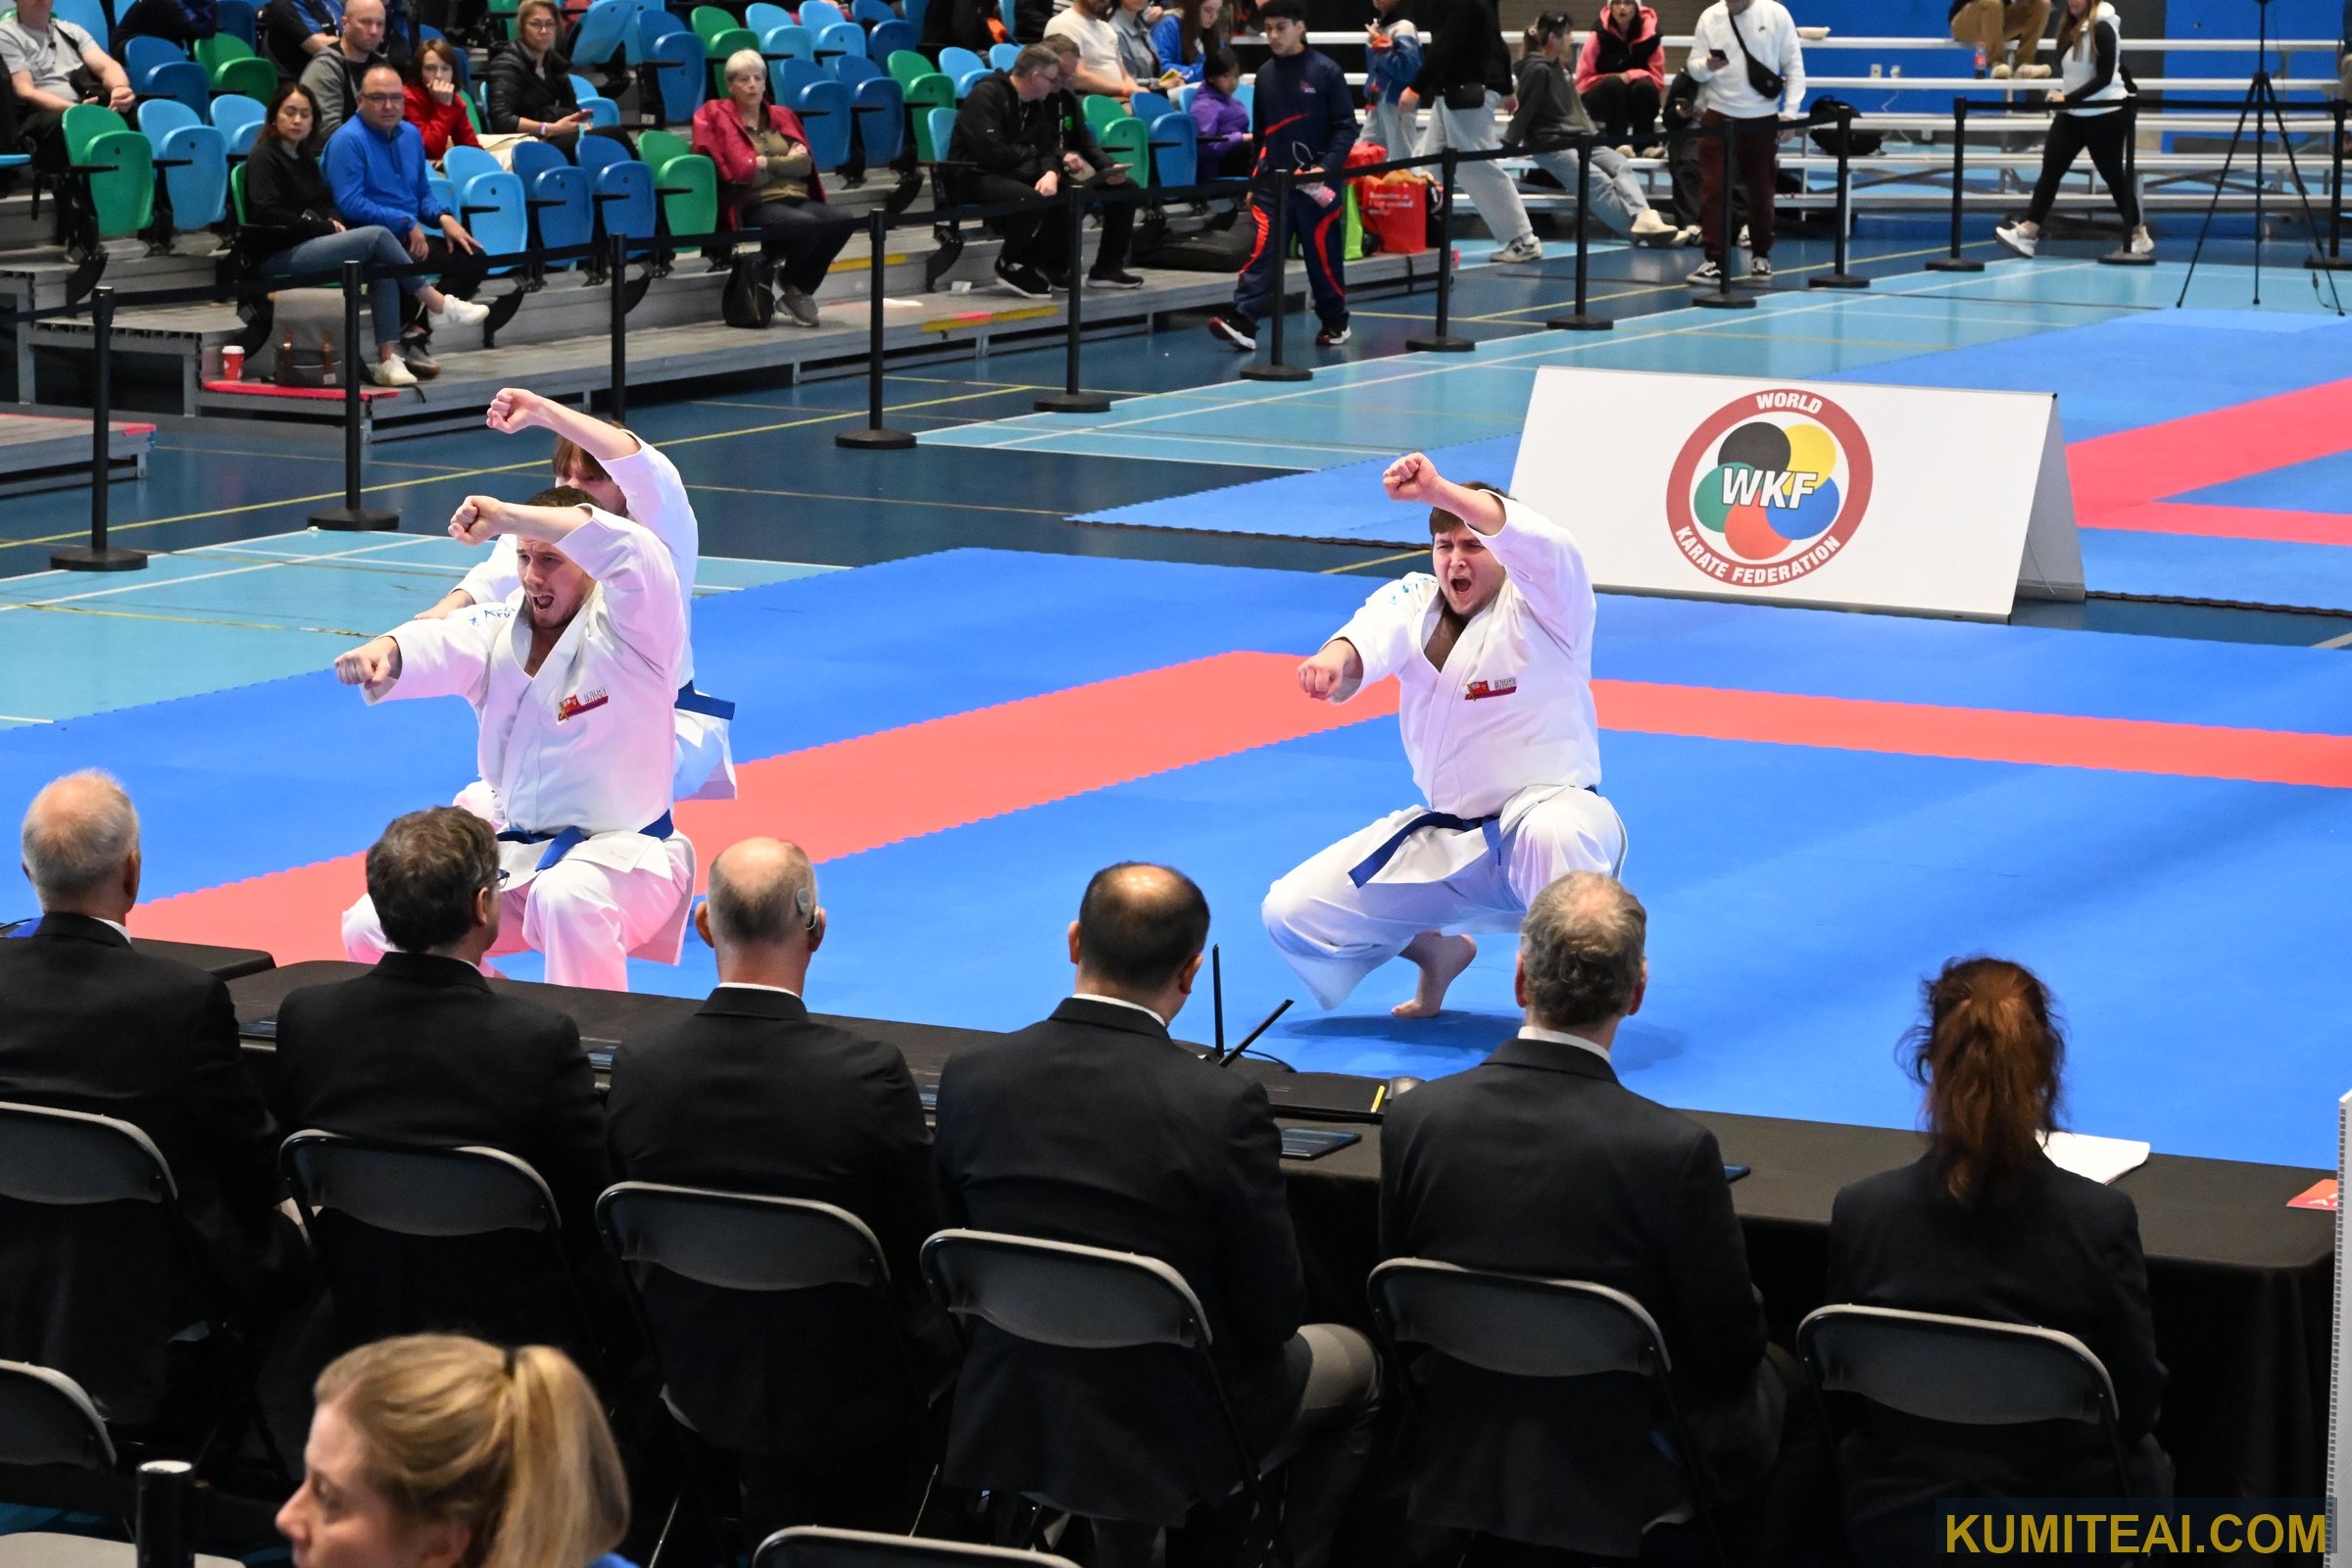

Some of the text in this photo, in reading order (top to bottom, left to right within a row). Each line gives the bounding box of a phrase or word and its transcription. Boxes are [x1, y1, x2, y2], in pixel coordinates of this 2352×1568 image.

[1755, 393, 1823, 415] WORLD
[1721, 466, 1818, 510] WKF
[1675, 525, 1840, 584] KARATE FEDERATION
